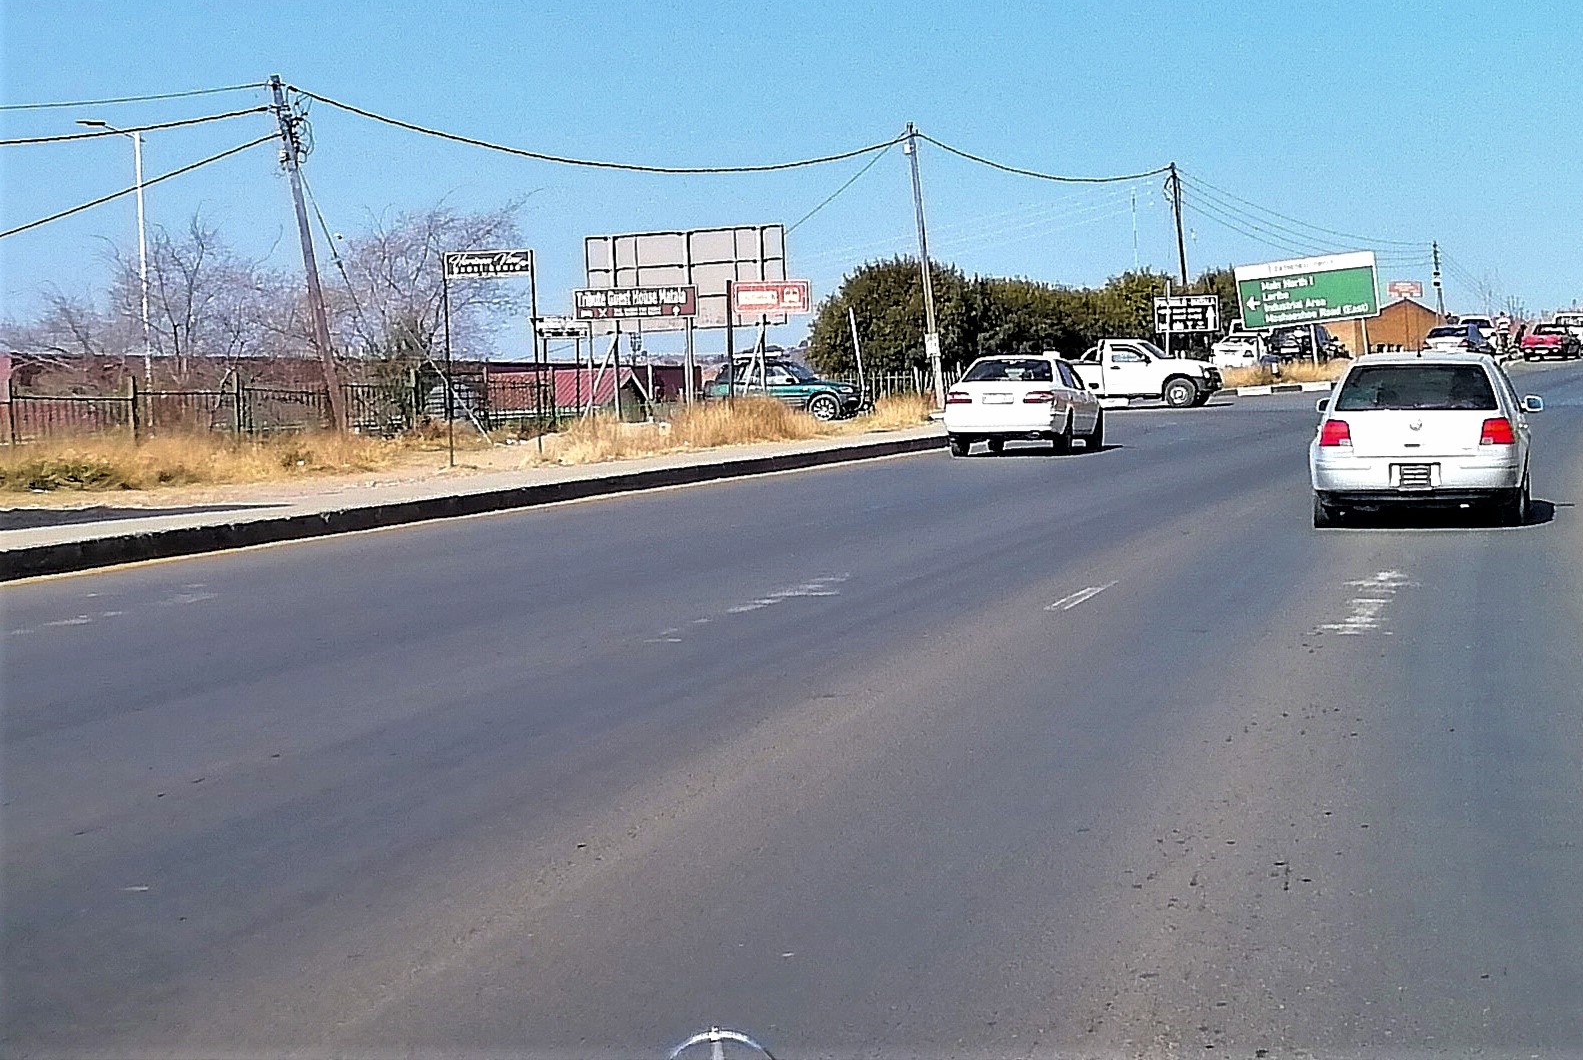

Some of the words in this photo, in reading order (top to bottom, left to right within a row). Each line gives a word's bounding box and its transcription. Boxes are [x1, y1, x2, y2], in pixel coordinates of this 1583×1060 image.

[576, 292, 606, 307] Tribute
[607, 290, 631, 306] Guest
[632, 289, 658, 305] House
[1264, 300, 1303, 312] Industrial
[1305, 298, 1327, 308] Area
[1319, 306, 1341, 317] Road
